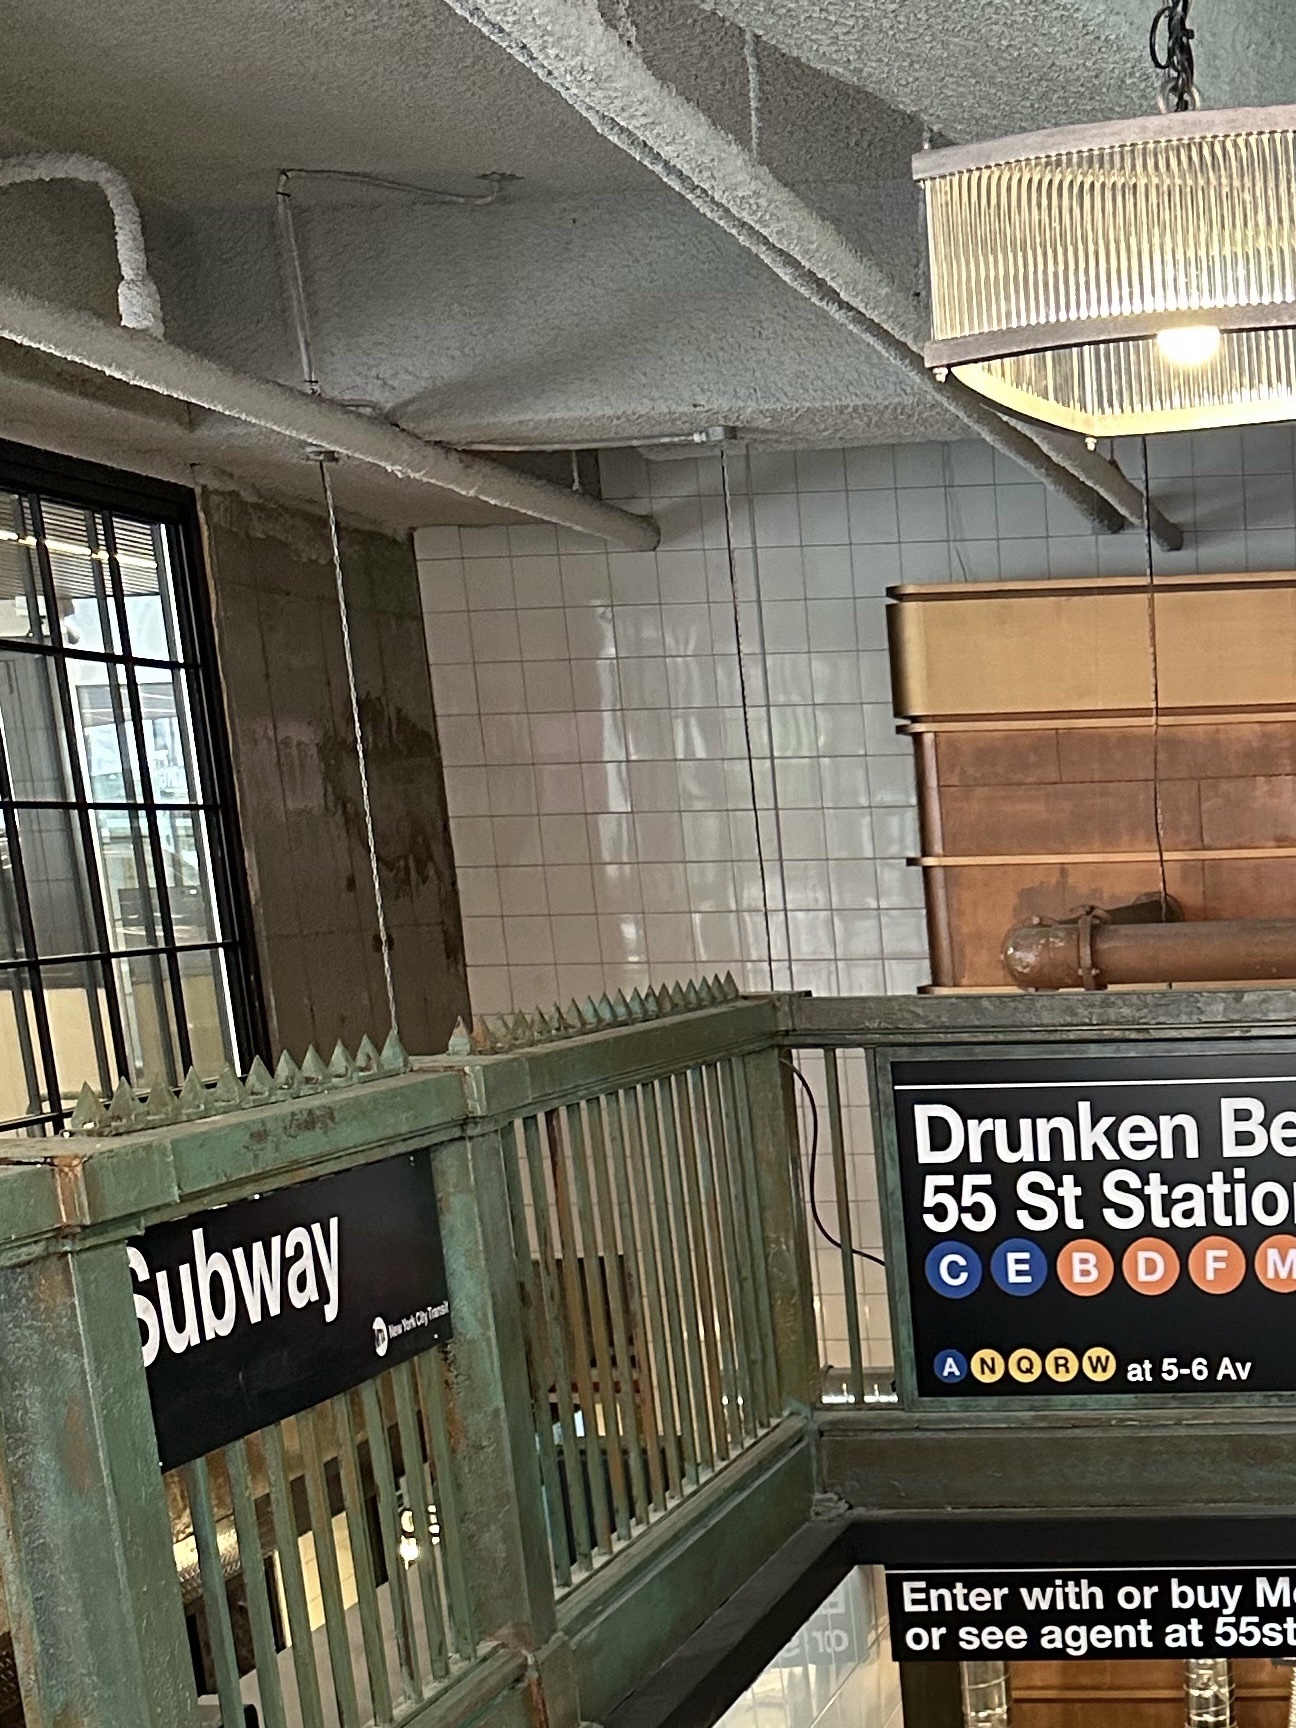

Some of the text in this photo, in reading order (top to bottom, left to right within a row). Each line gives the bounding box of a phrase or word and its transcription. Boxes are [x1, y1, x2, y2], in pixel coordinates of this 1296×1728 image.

[914, 1101, 1198, 1164] Drunken
[923, 1174, 996, 1233] 55
[1017, 1171, 1083, 1231] St
[126, 1216, 339, 1367] Subway
[1126, 1359, 1152, 1381] at
[1161, 1358, 1208, 1381] 5-6
[1217, 1357, 1252, 1381] Av
[903, 1581, 1008, 1612] Enter
[1020, 1578, 1103, 1610] with
[1118, 1585, 1158, 1610] or
[1172, 1578, 1242, 1615] buy
[905, 1627, 946, 1651] or
[959, 1625, 1027, 1650] see
[1041, 1619, 1153, 1656] agent
[1165, 1618, 1203, 1648] at
